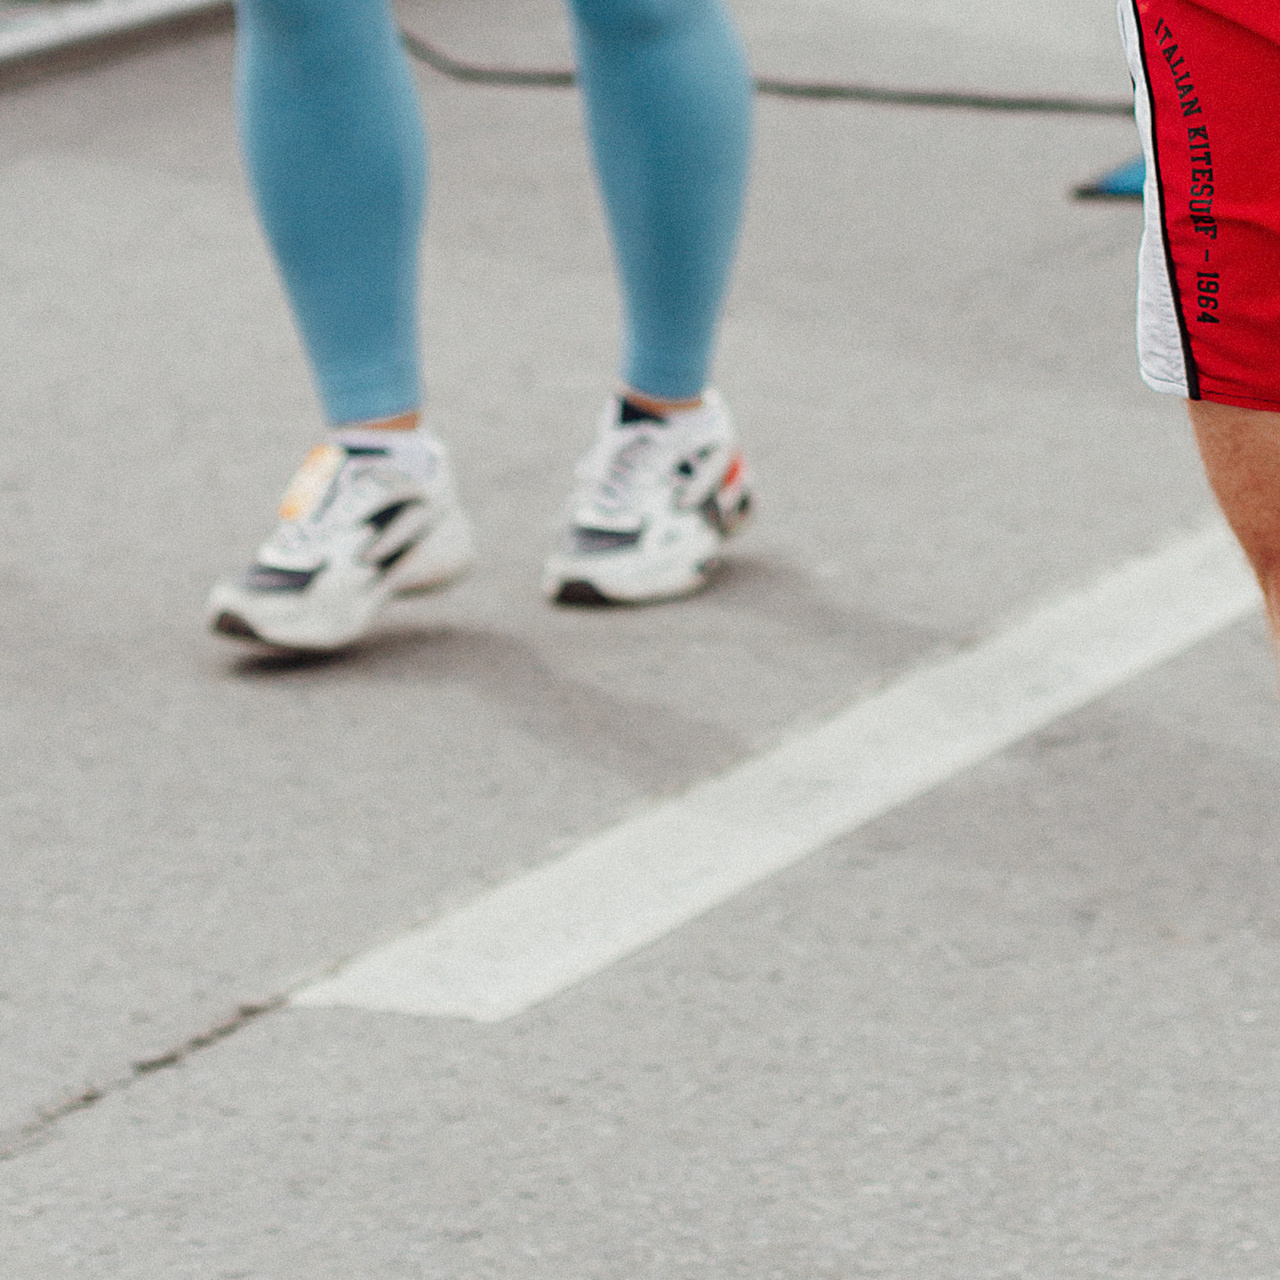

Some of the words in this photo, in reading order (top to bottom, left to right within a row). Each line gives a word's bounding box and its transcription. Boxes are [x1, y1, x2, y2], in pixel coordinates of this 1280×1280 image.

[1154, 17, 1203, 117] ITALIAN
[1187, 125, 1218, 240] KITESURF
[1197, 271, 1220, 324] 1964
